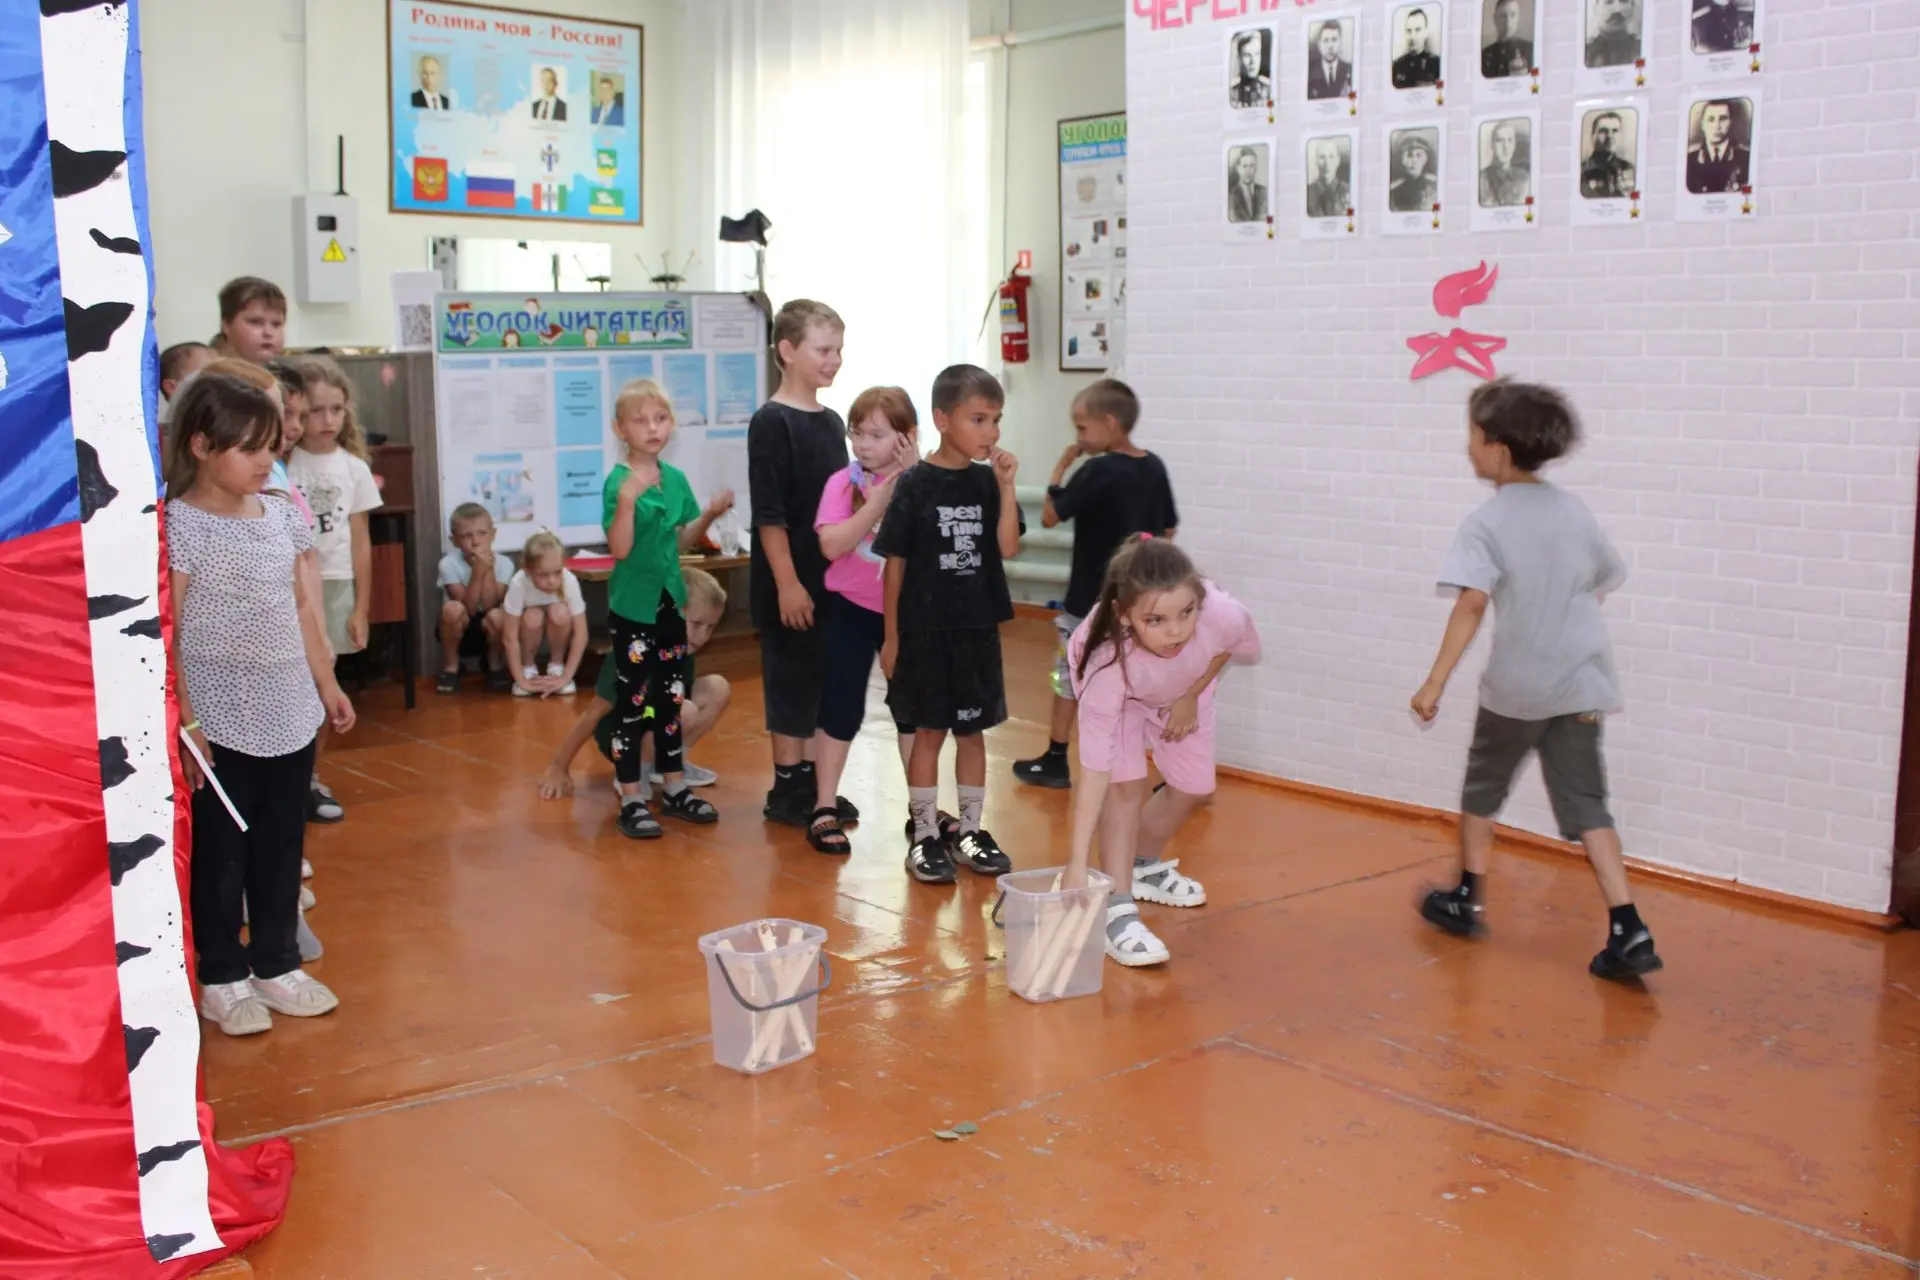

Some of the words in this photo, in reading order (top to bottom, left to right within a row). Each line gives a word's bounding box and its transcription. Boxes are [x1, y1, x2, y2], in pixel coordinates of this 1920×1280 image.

[411, 8, 487, 32] Родина
[493, 21, 532, 37] моя
[551, 24, 624, 49] Россия!
[445, 310, 549, 336] УГОЛОК
[558, 309, 687, 333] ЧИТАТЕЛЯ
